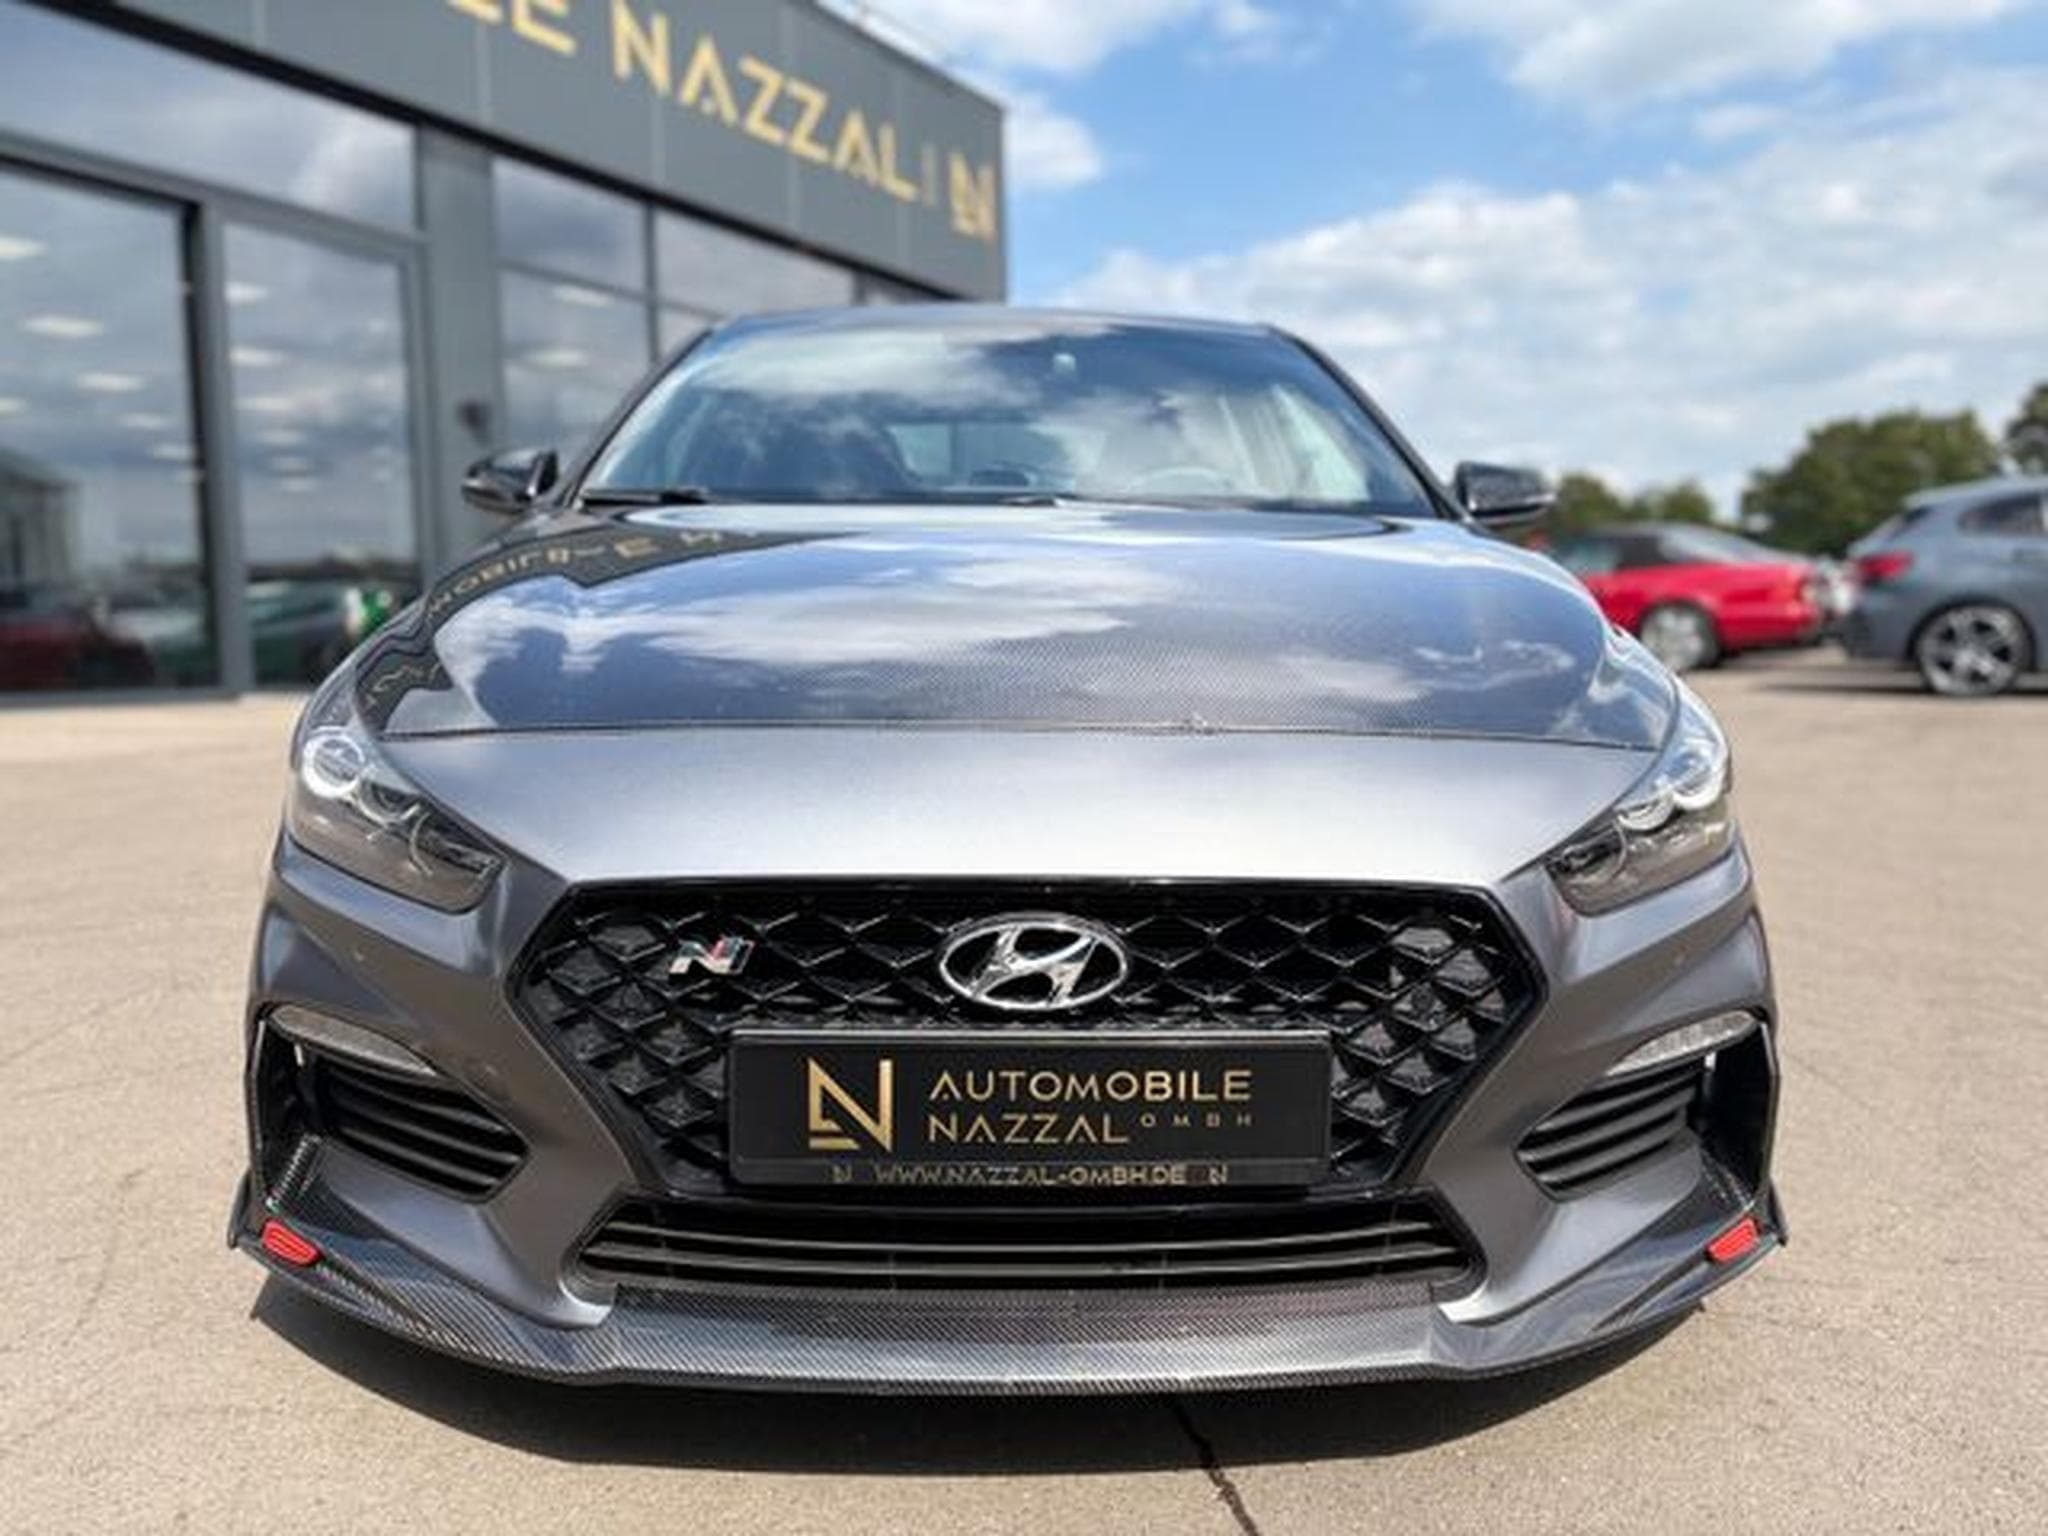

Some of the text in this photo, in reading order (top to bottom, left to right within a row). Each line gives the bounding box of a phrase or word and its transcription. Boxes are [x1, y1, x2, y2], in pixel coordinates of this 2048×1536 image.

[609, 0, 918, 201] NAZZAL
[929, 1070, 1252, 1100] AUTOMOBILE
[929, 1113, 1129, 1144] NAZZAL
